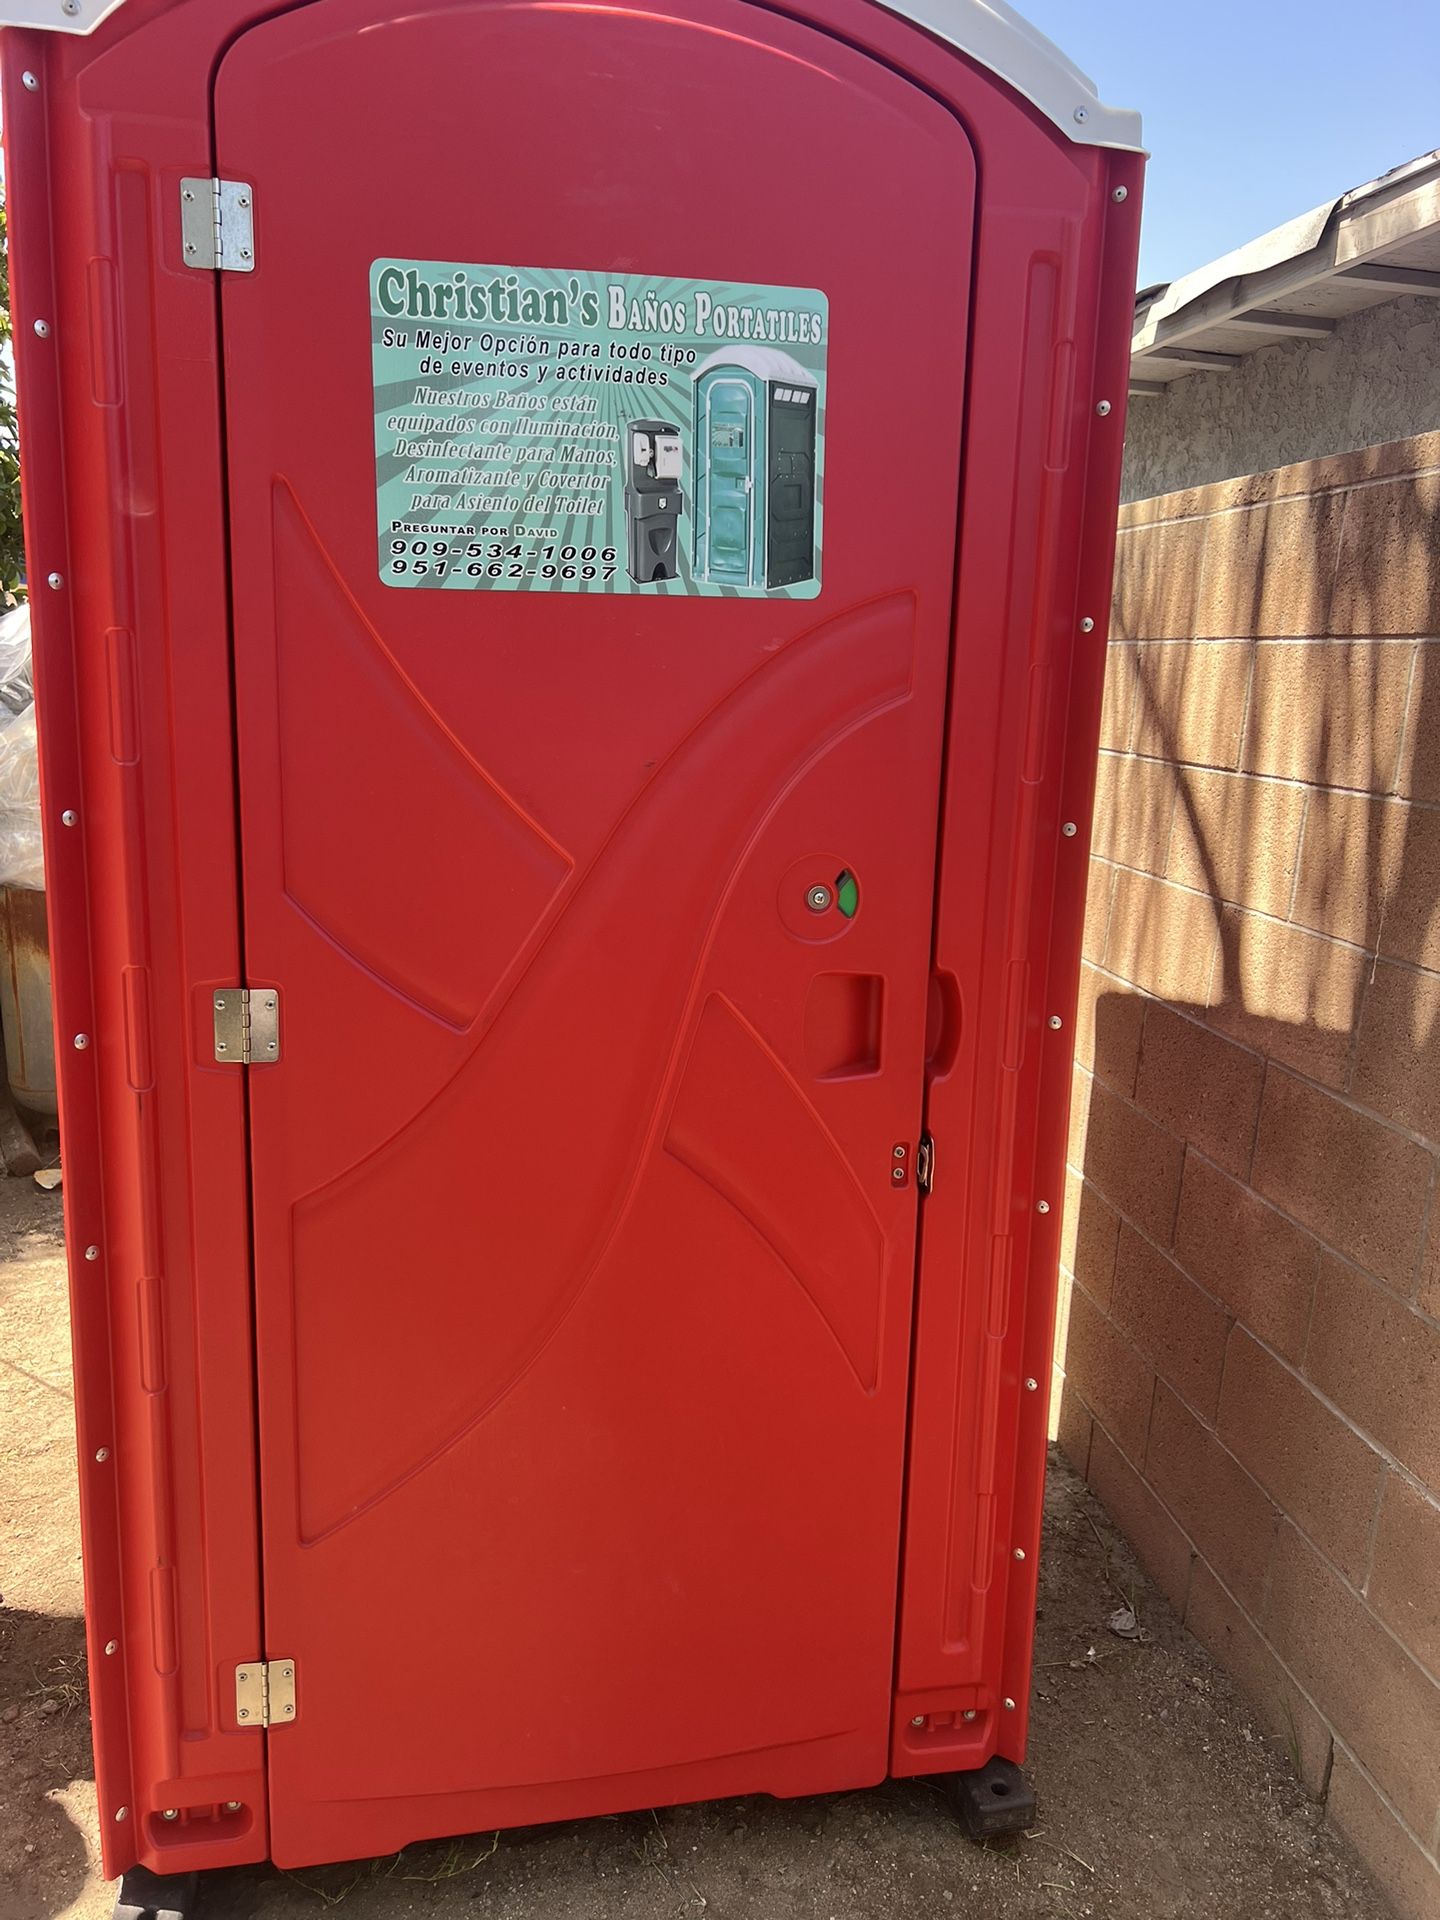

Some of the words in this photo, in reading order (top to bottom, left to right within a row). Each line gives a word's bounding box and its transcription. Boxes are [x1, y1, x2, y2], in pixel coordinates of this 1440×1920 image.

[378, 267, 599, 327] Christian's
[383, 329, 407, 348] Su
[416, 329, 472, 354] Mejor
[480, 333, 550, 357] Opción
[558, 342, 601, 359] para
[609, 342, 652, 361] todo
[660, 344, 696, 366] tipo
[420, 356, 442, 374] de
[451, 360, 529, 378] eventos
[537, 364, 549, 383] y
[556, 364, 668, 386] actividades
[414, 387, 490, 407] Nuestros
[493, 391, 547, 412] Baños
[551, 392, 598, 412] están
[387, 414, 475, 434] equipados
[479, 420, 512, 434] con
[515, 416, 620, 441] Iluminación,
[394, 439, 512, 460] Desinfectante
[515, 446, 554, 464] para
[560, 445, 617, 466] Manos,
[403, 464, 521, 487] Aromatizante
[524, 474, 536, 488] y
[539, 470, 611, 491] Covertor
[410, 494, 450, 511] para
[455, 493, 519, 513] Asiento
[523, 496, 550, 513] del
[554, 496, 606, 515] Toilet
[481, 526, 509, 537] POR
[391, 539, 617, 562] 909-534-1006
[391, 559, 618, 581] 951-662-9697
